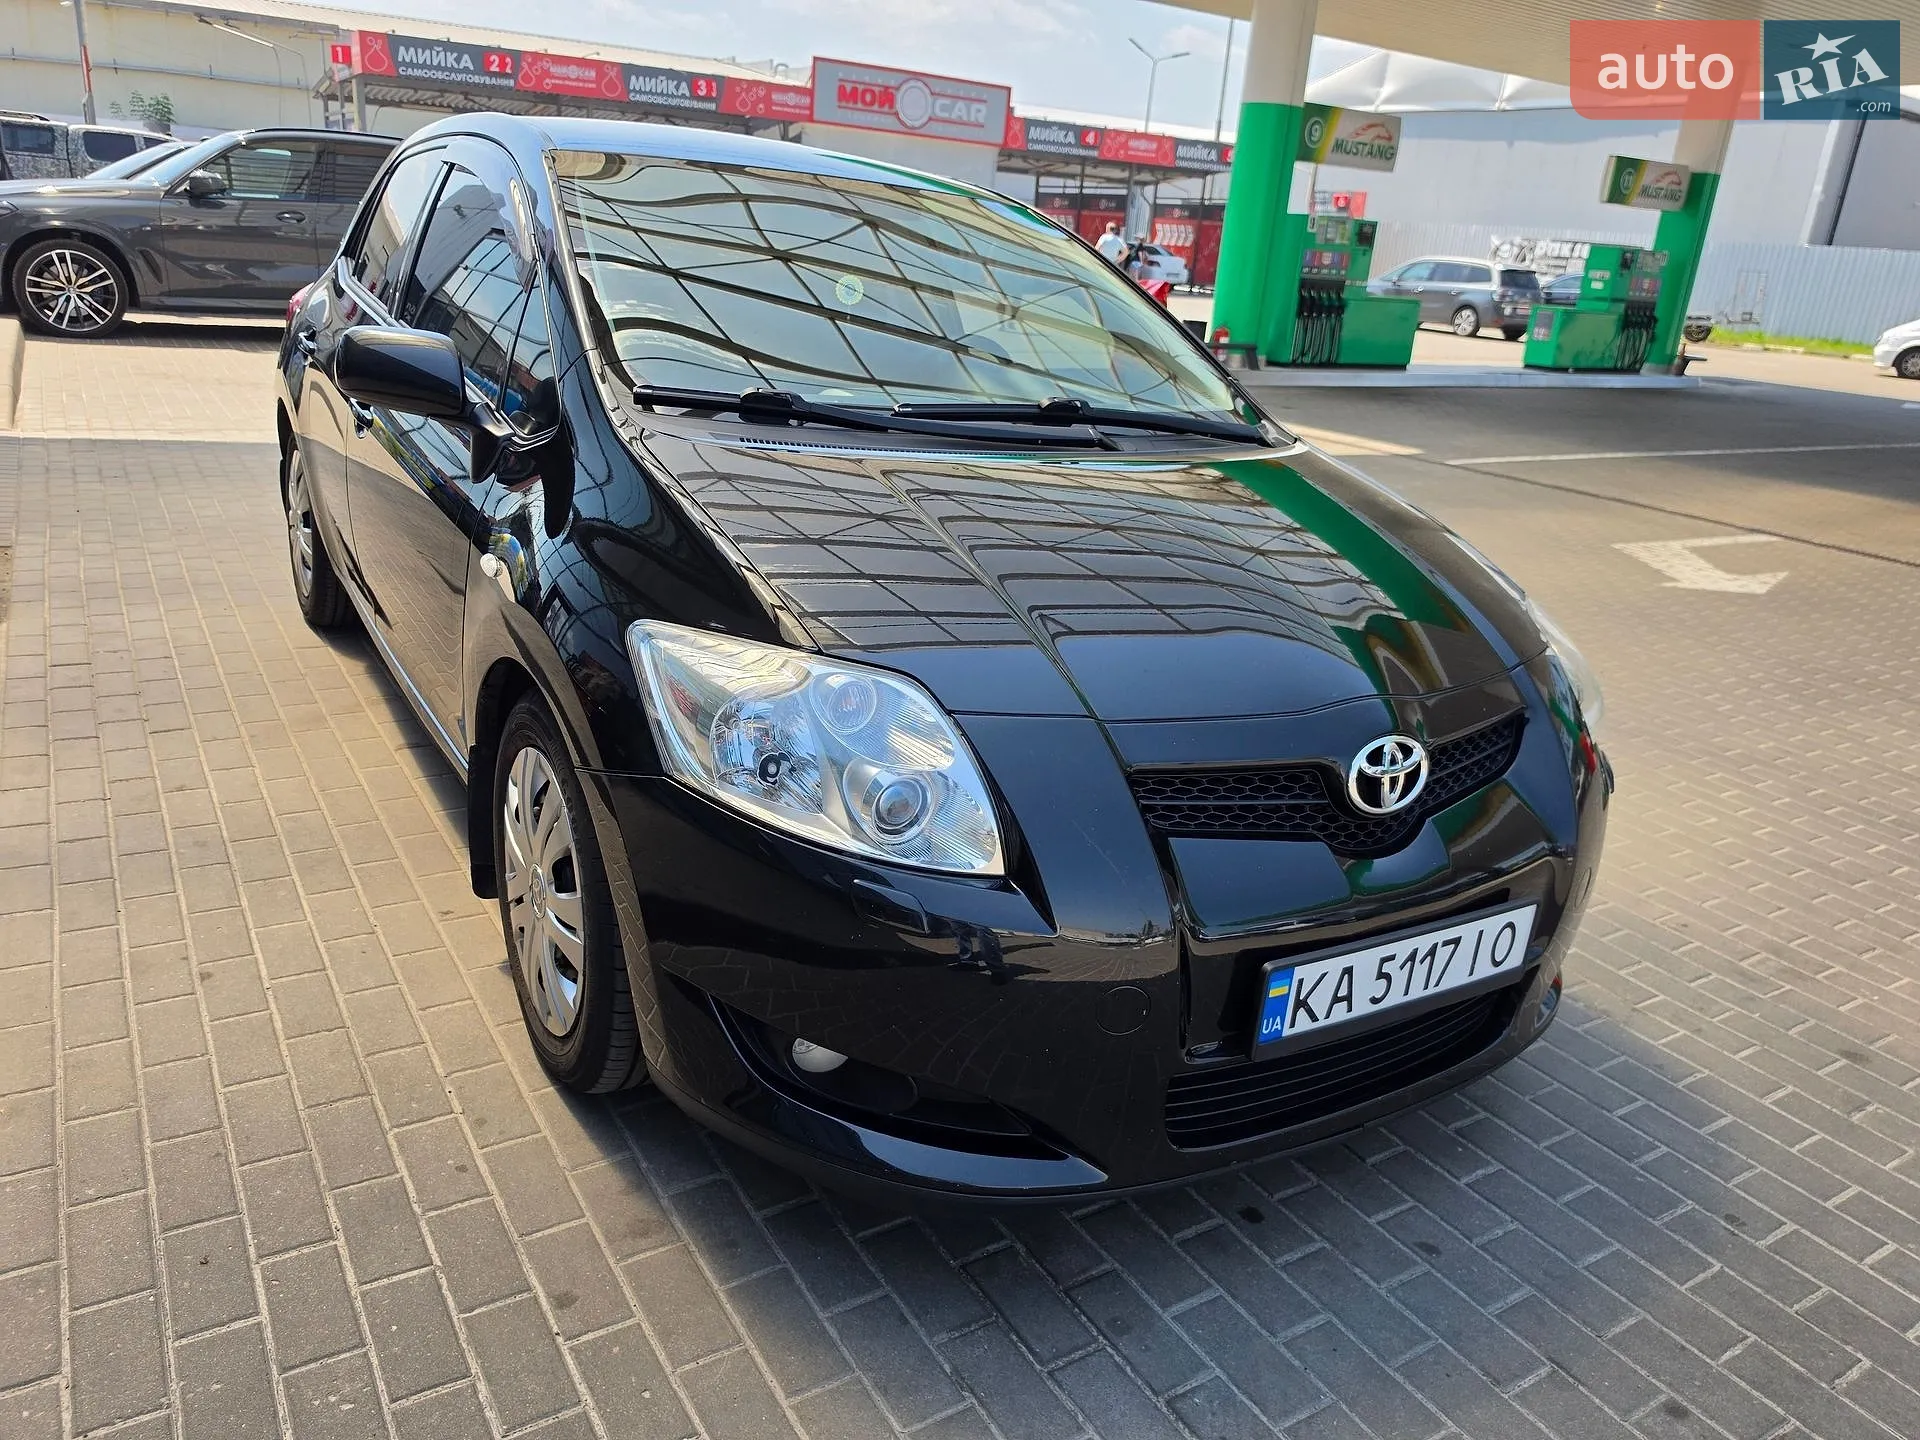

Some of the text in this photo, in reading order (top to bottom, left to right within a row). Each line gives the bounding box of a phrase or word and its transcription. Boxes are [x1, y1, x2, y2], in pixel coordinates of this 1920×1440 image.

[336, 47, 343, 63] 1
[398, 45, 500, 72] МИЙКА 2
[629, 75, 707, 98] МИЙКА 3
[837, 84, 896, 110] МОЙ
[934, 100, 987, 123] CAR
[1028, 126, 1096, 146] МИЙКА 4
[1331, 137, 1396, 160] MUSTANG
[1639, 184, 1683, 202] MUSTANG
[1288, 964, 1355, 1029] KA
[1368, 935, 1462, 1005] 5117
[1261, 1016, 1283, 1035] UA
